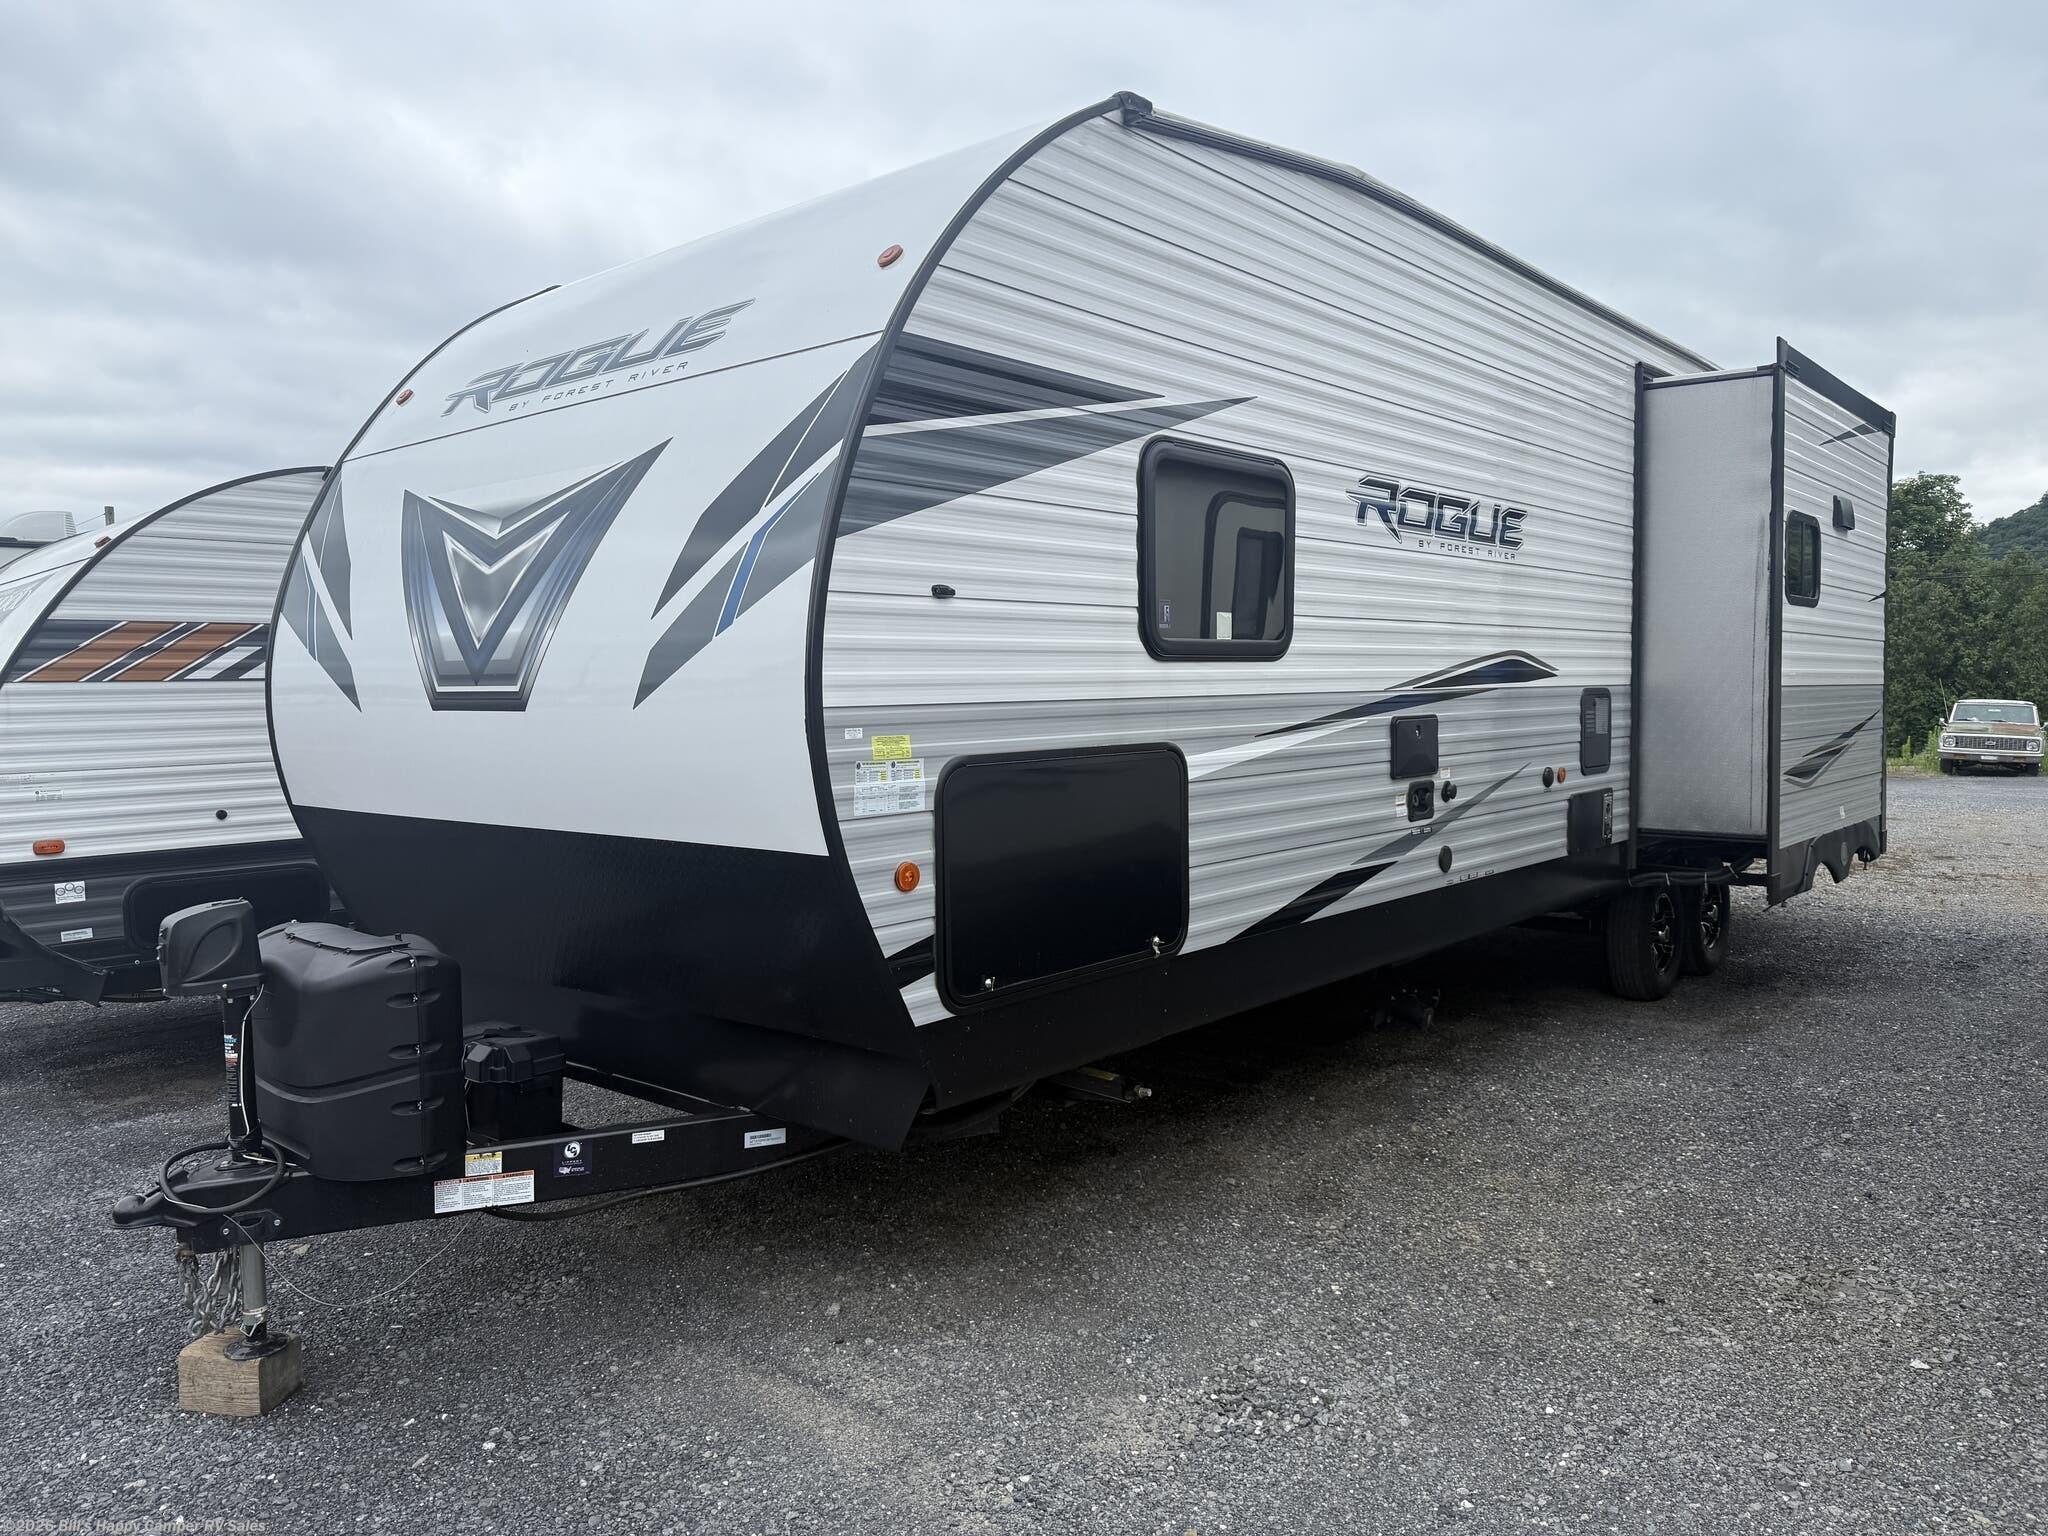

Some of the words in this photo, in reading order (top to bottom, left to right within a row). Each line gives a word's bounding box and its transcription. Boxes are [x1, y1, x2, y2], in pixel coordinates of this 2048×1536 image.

[441, 298, 756, 418] ROGUE
[508, 399, 530, 412] BY
[541, 379, 615, 403] FOREST
[627, 361, 689, 383] RIVER
[1345, 474, 1528, 551] ROGUE
[1418, 539, 1432, 549] BY
[1439, 542, 1481, 556] FOREST
[1487, 549, 1516, 561] RIVER
